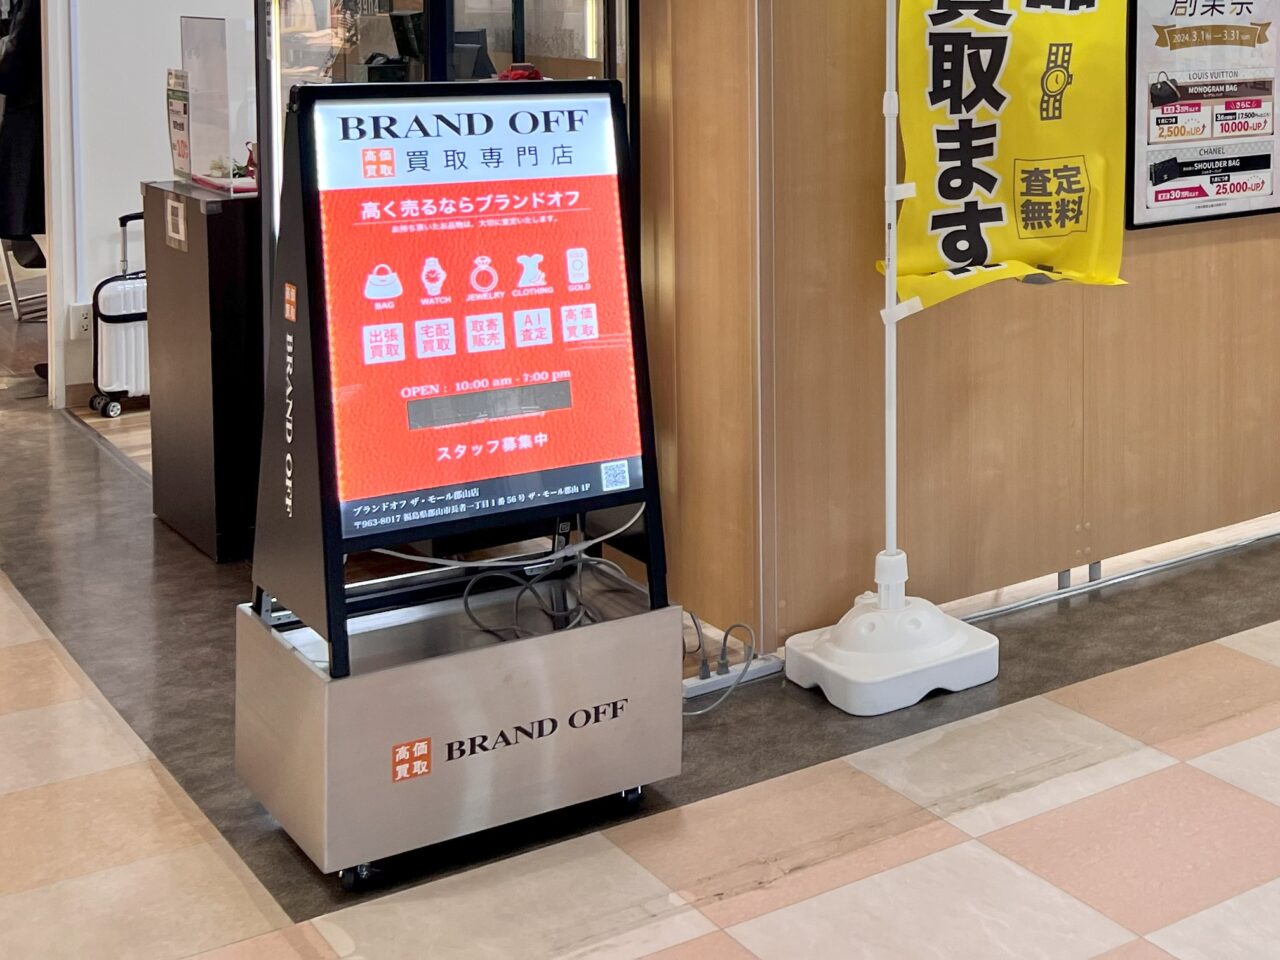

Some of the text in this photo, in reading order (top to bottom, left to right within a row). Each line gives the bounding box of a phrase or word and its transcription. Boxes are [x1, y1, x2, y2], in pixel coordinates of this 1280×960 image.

[1188, 71, 1239, 80] LOUIS VUITTON
[1188, 84, 1238, 94] MONOGRAM BAG
[337, 108, 589, 141] BRAND OFF
[364, 149, 393, 162] 高価
[405, 143, 574, 173] 買取専門店
[1199, 147, 1225, 156] CHANEL
[365, 164, 394, 177] 買取
[1194, 160, 1227, 170] SHOULDER
[1228, 159, 1240, 167] BAG
[1020, 165, 1085, 197] 査定
[361, 191, 580, 221] 高く売るならブランドオフ
[1020, 195, 1083, 230] 無料
[512, 286, 554, 297] CLOTHING
[568, 282, 591, 292] GOLD
[420, 296, 452, 305] WATCH
[466, 291, 505, 302] JEWELRY
[374, 301, 395, 310] BAG
[565, 307, 593, 321] 高価
[421, 323, 450, 338] 宅配
[455, 378, 489, 392] 10:00
[492, 376, 512, 387] am
[551, 370, 571, 381] pm
[285, 334, 294, 518] BRAND OFF
[437, 432, 549, 462] スタッフ募集中
[353, 499, 408, 517] ブランドオフ
[445, 698, 629, 762] BRAND OFF
[395, 741, 428, 762] 高価
[395, 760, 429, 781] 買取
